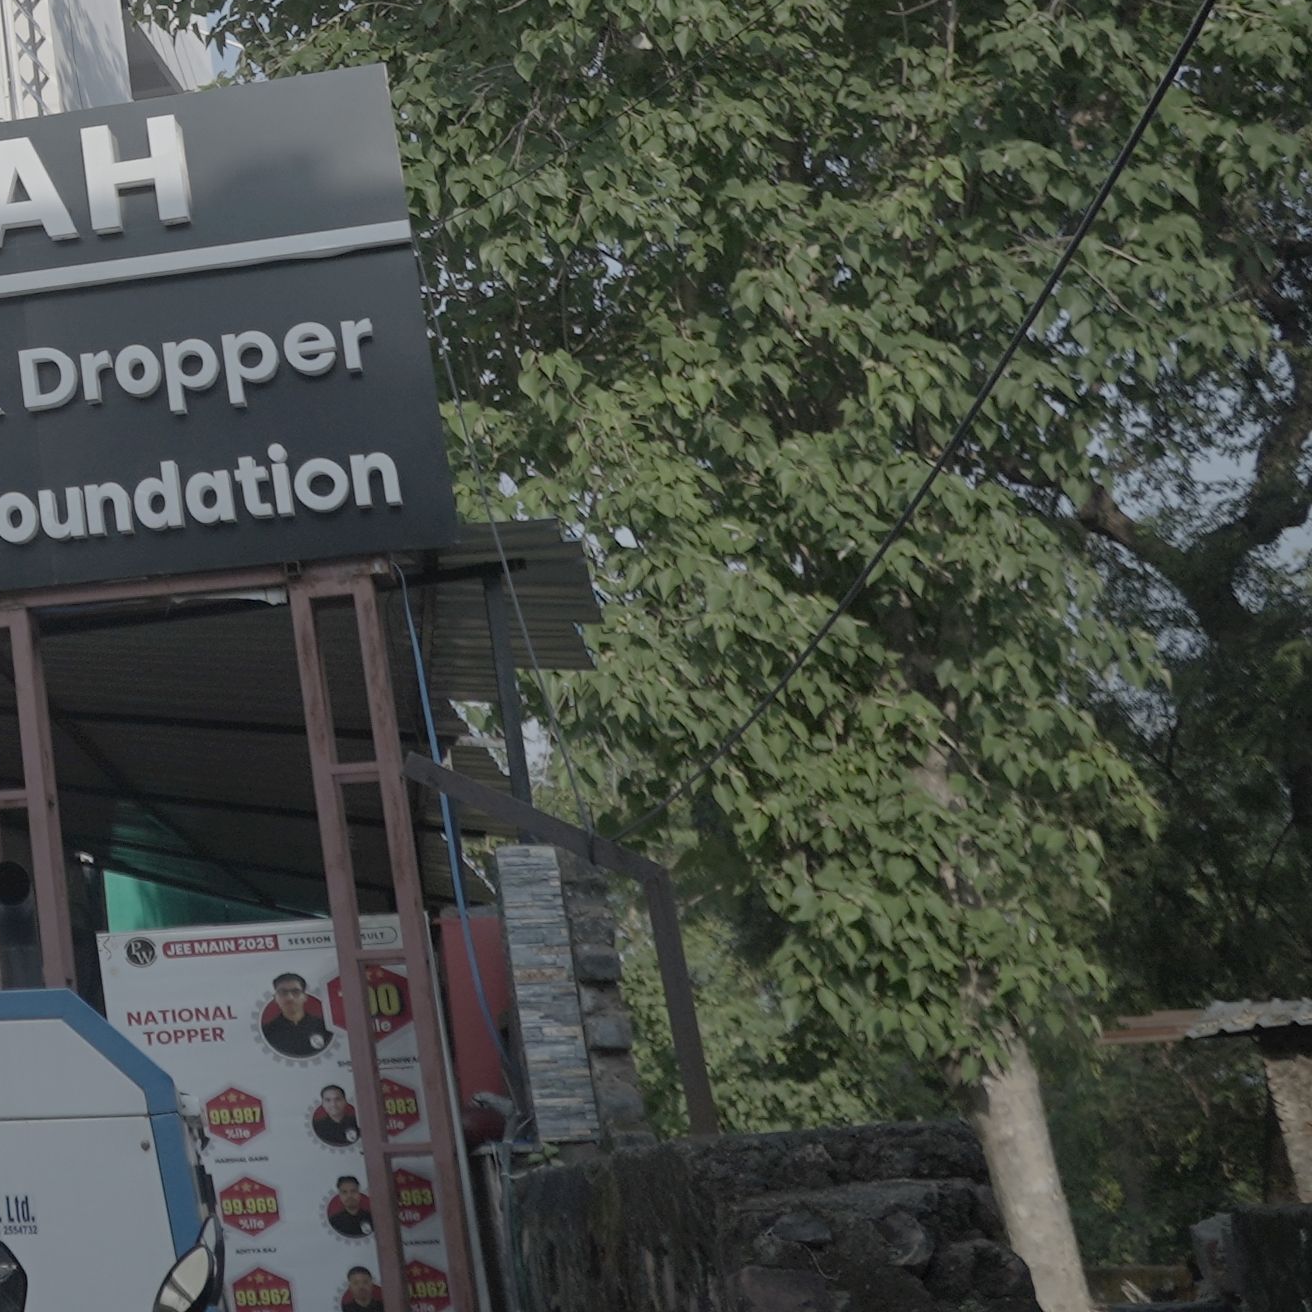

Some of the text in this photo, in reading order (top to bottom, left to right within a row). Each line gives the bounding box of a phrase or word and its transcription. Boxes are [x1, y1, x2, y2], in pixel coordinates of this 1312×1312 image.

[18, 318, 374, 415] Dropper
[166, 943, 192, 956] JEE
[194, 940, 236, 955] MAIN
[287, 935, 332, 946] SESSION
[361, 931, 385, 941] SULT
[368, 983, 401, 1017] 00
[126, 1005, 238, 1027] NATIONAL
[142, 1027, 226, 1047] TOPPER
[209, 1106, 262, 1126] 99.987
[5, 1195, 36, 1224] Ltd.
[221, 1197, 277, 1216] 99.969
[235, 1288, 291, 1308] 99.962
